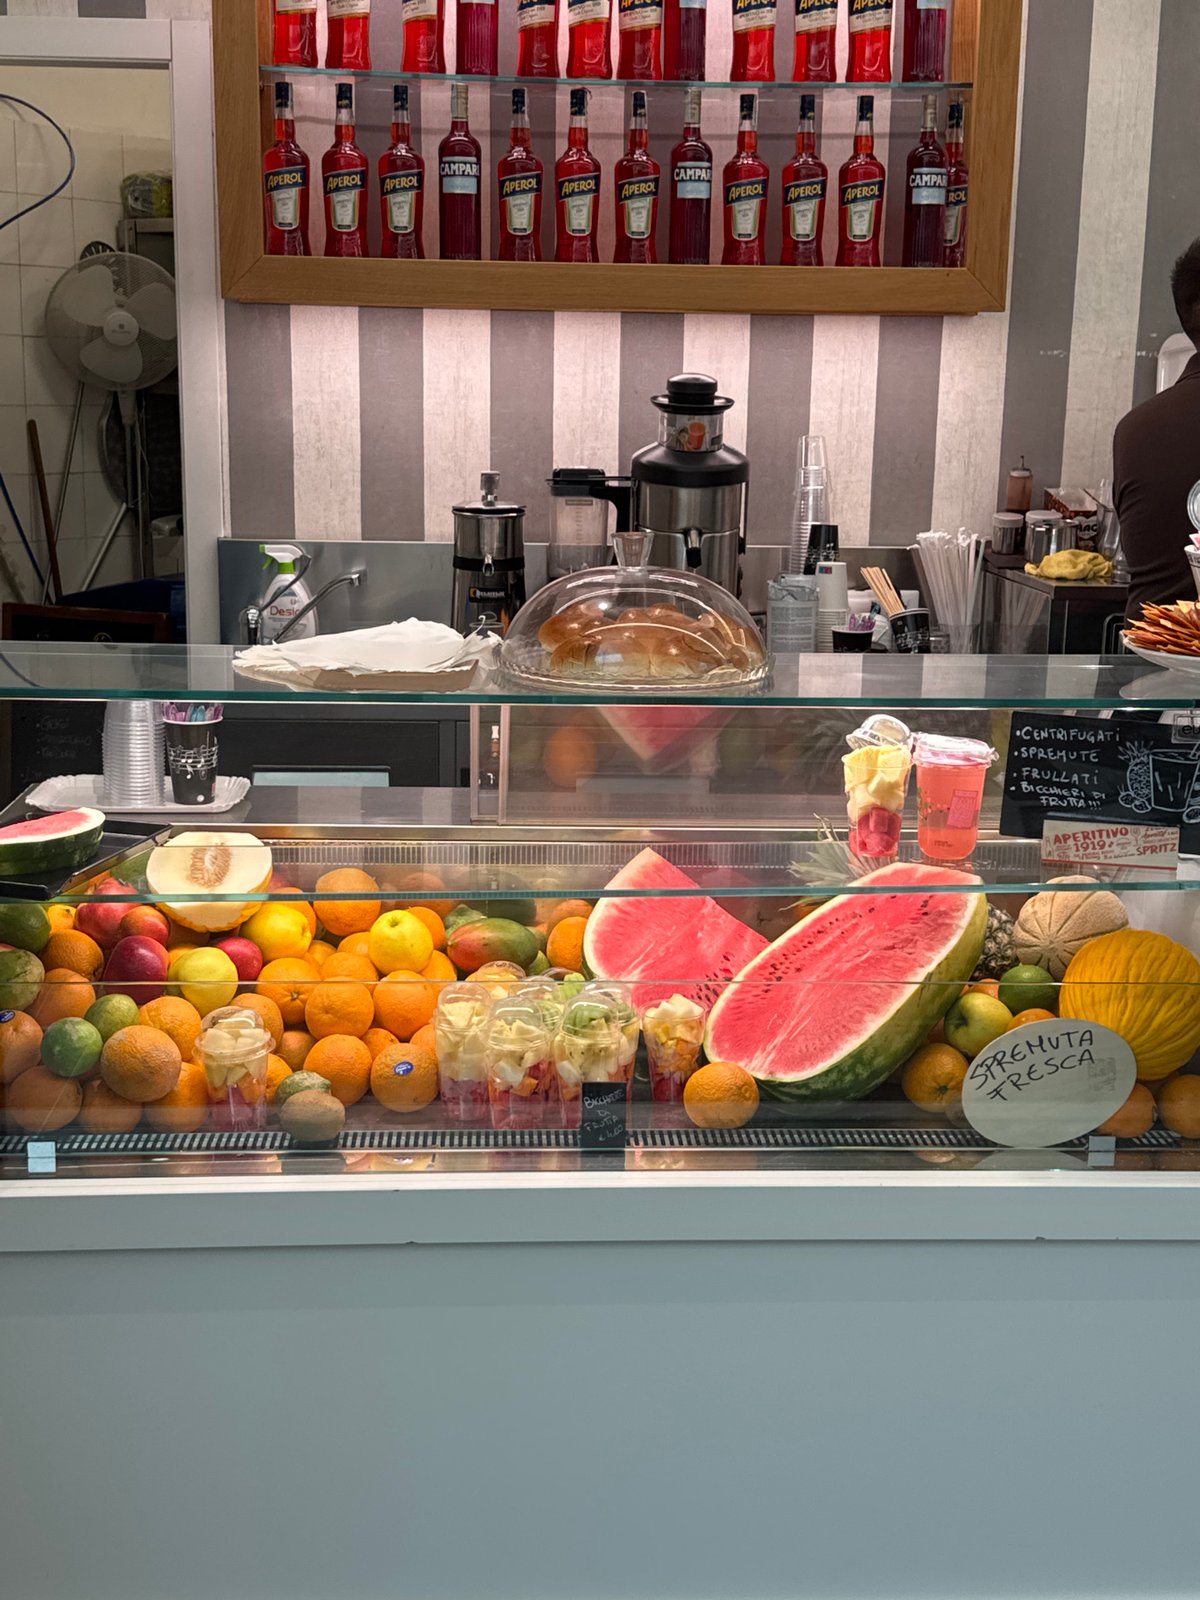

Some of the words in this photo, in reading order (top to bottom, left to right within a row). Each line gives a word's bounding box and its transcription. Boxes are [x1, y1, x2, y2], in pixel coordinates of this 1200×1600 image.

[267, 172, 302, 189] APEROL
[327, 174, 361, 190] APEROL
[674, 168, 712, 181] CAMPAR
[910, 175, 947, 187] CAMPAR
[384, 176, 418, 192] APEROL
[503, 178, 538, 195] APEROL
[562, 179, 596, 196] APEROL
[622, 182, 656, 199] APEROL
[729, 183, 763, 200] APEROL
[788, 184, 822, 200] APEROL
[845, 185, 879, 202] APEROL
[948, 191, 967, 202] ROL
[1021, 747, 1099, 763] SPREMUTE
[1020, 781, 1085, 798] BICCHIERI
[1053, 826, 1129, 845] APERITIVO
[1074, 840, 1107, 853] 1919
[1136, 843, 1177, 856] SPRITZ
[969, 1029, 1094, 1090] SPREMUTA
[986, 1049, 1095, 1101] FRESCA
